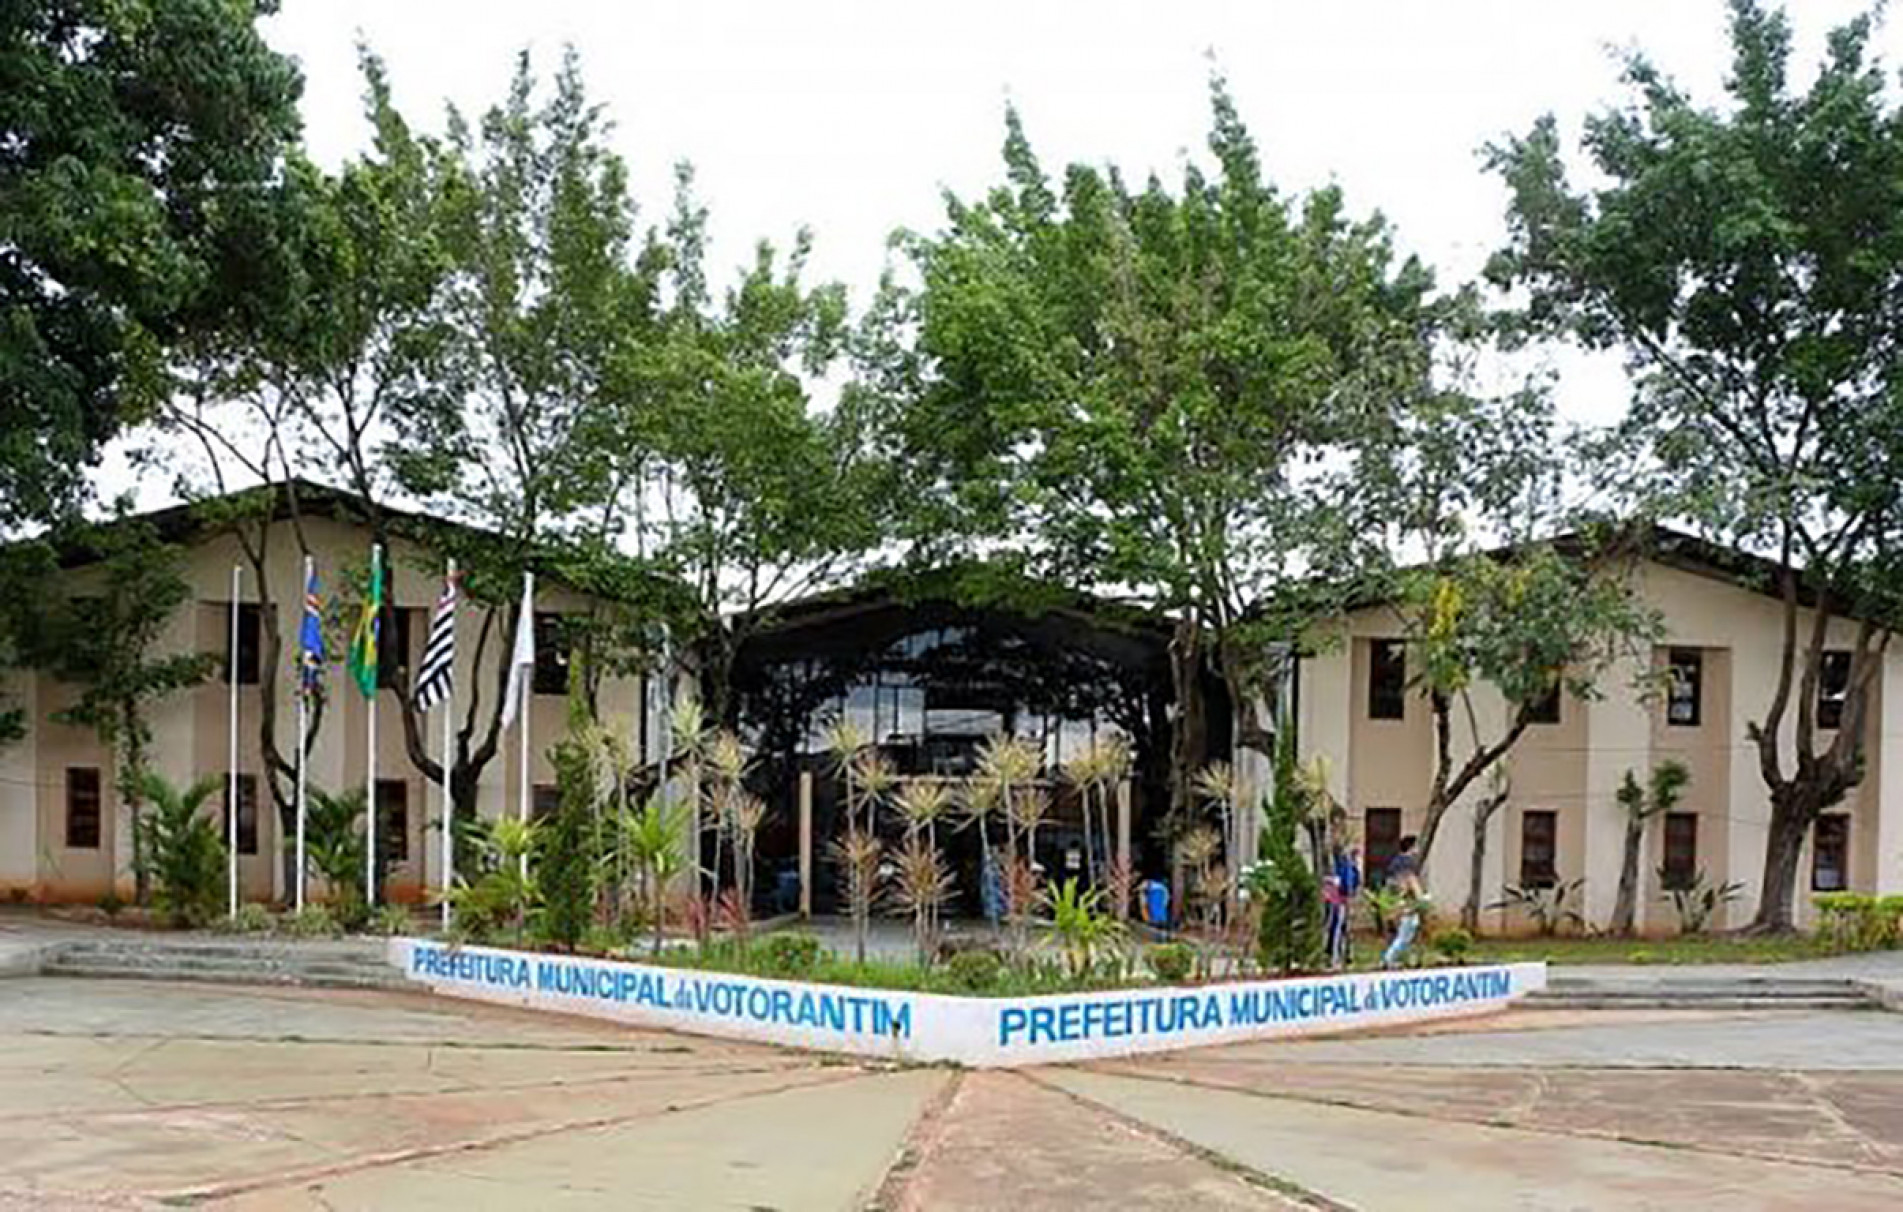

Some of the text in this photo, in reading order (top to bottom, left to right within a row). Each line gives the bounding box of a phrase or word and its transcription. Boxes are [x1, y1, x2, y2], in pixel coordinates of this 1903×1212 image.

[413, 947, 530, 988] PREFEITURA
[538, 963, 671, 1009] MUNICIPAL
[694, 980, 911, 1038] VOTORANTIM
[1000, 971, 1511, 1046] PREFEITURA MUNICIPAL d VOTORANTIM
